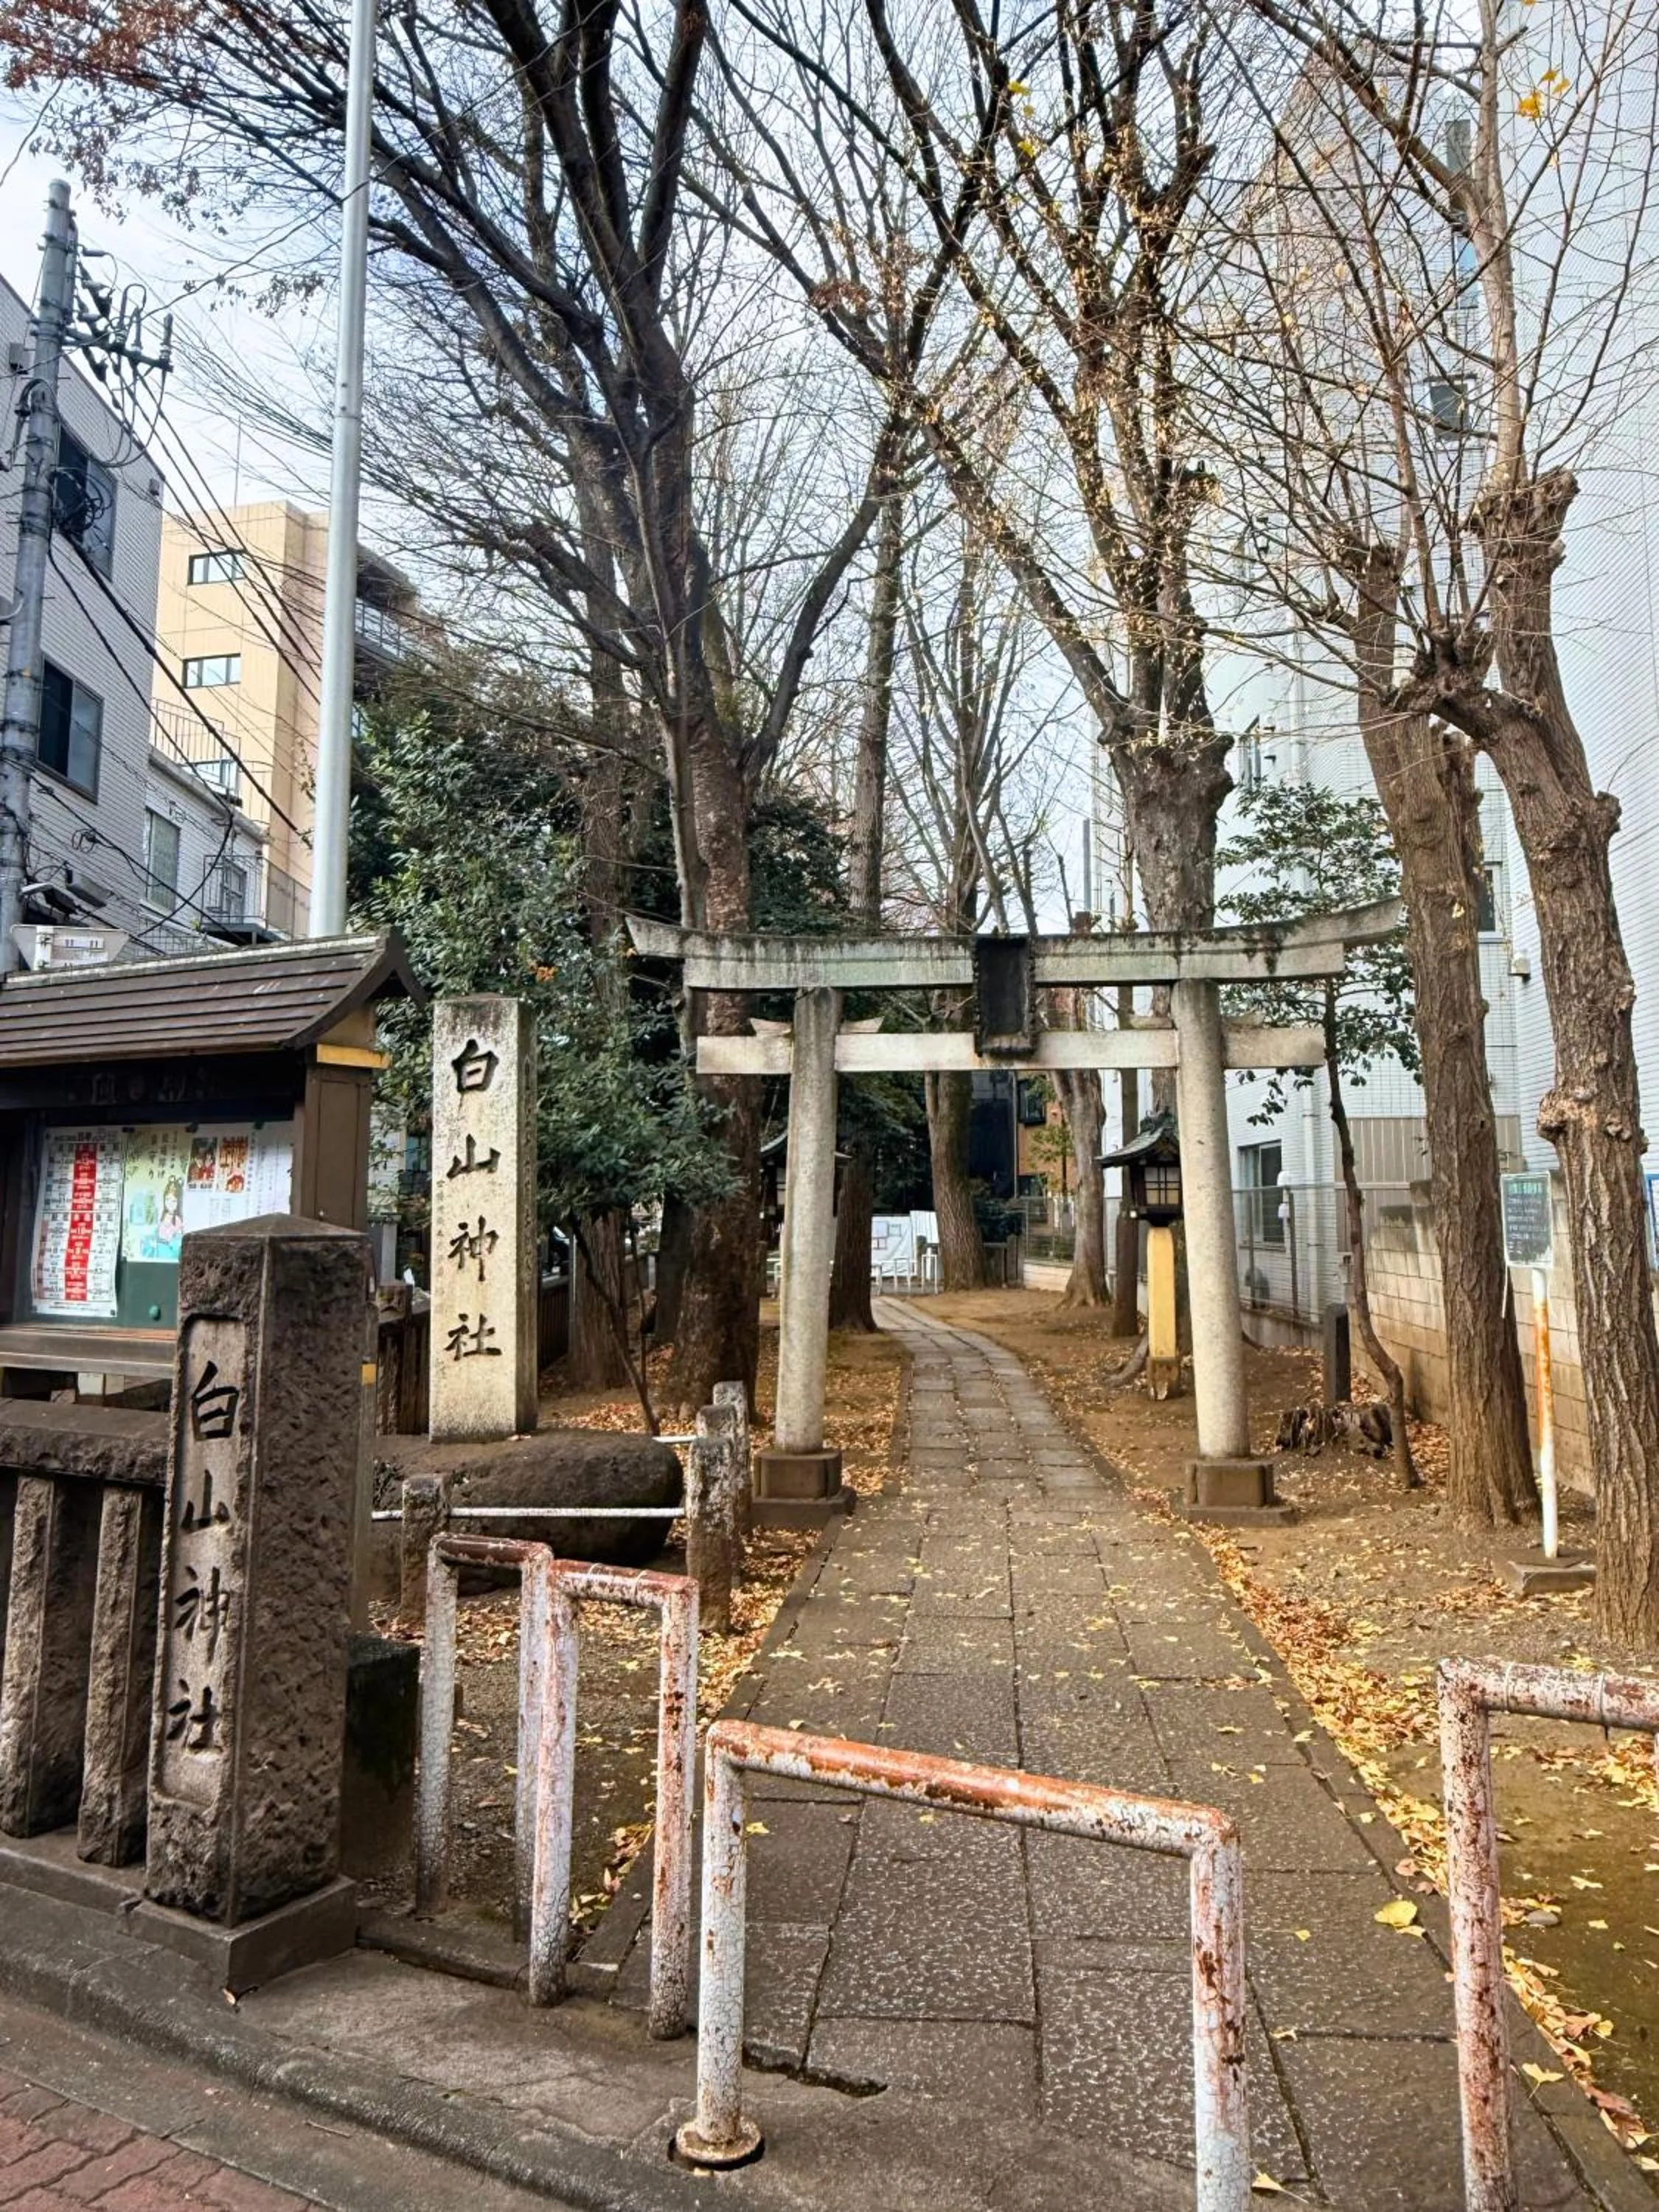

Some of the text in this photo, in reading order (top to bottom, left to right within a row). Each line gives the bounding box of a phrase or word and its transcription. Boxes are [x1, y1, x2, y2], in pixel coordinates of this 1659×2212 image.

[445, 1039, 502, 1361] 白山神社
[166, 1360, 239, 1750] 白山神社
